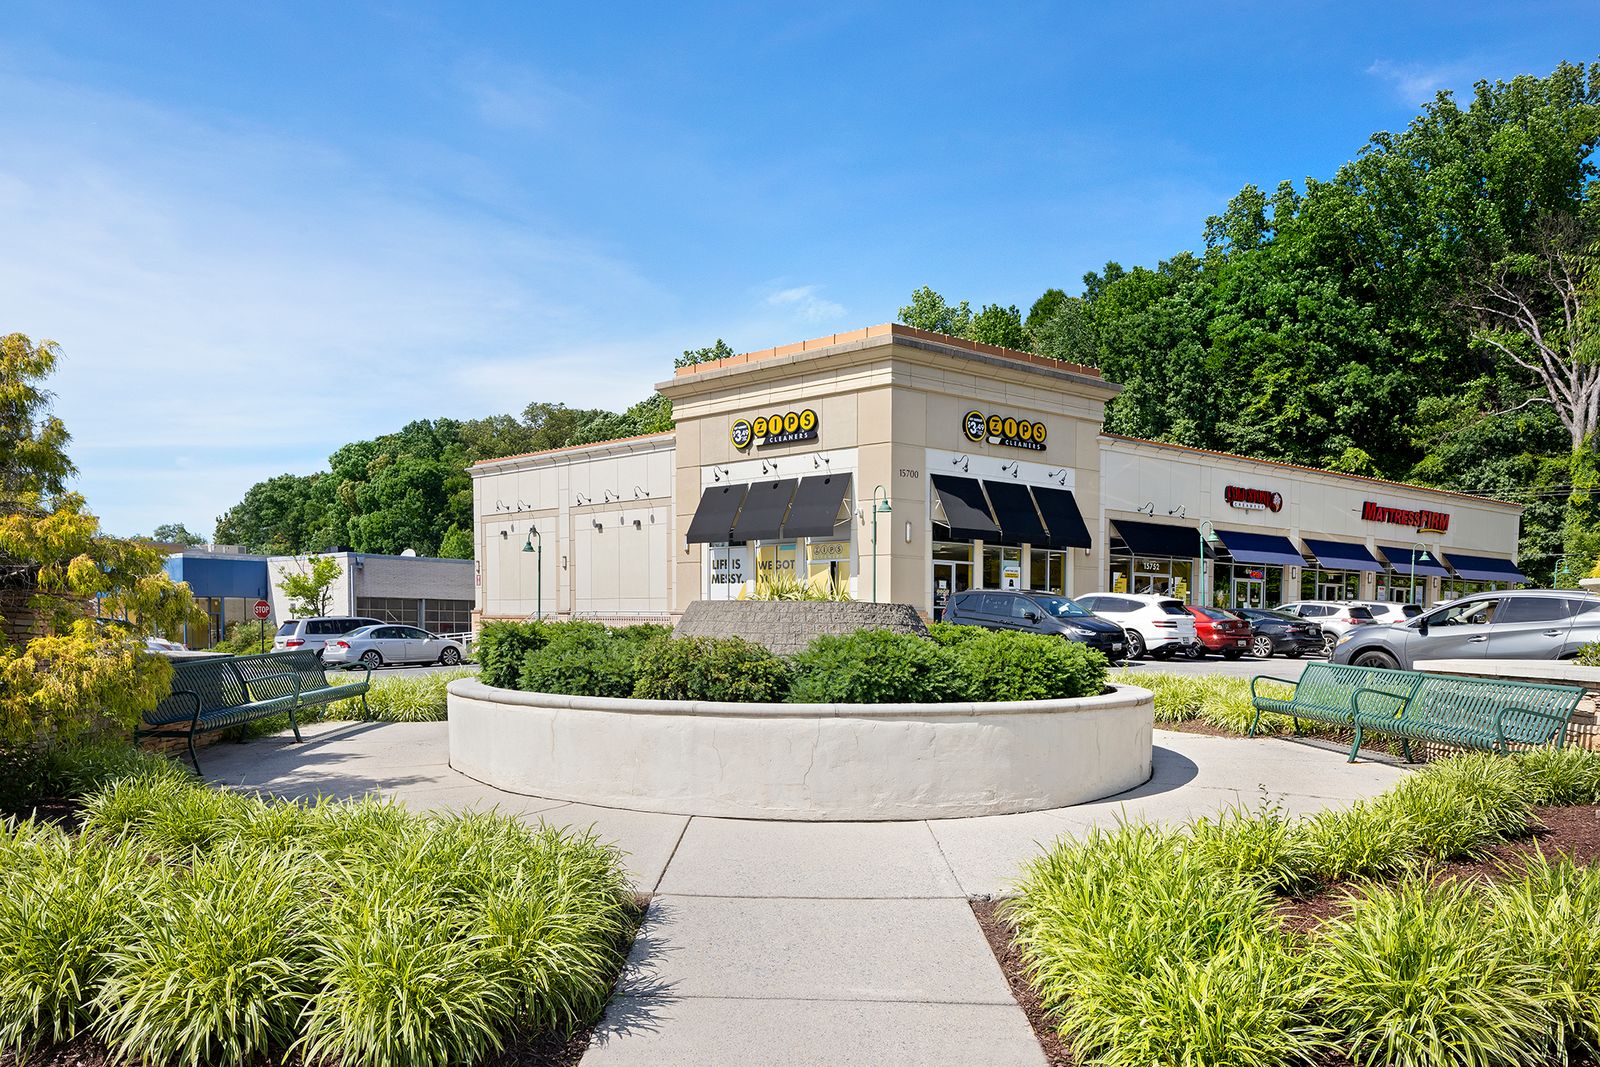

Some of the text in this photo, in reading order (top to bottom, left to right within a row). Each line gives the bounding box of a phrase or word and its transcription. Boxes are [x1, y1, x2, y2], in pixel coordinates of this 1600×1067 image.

[756, 413, 811, 434] ZIPS
[991, 418, 1043, 439] ZIPS
[769, 432, 808, 443] CLEANERS
[1005, 439, 1040, 450] CLEANERS
[899, 469, 919, 478] 15700
[732, 559, 741, 570] IS
[758, 559, 795, 570] WE GOT
[1143, 562, 1160, 571] 15752
[711, 573, 744, 584] MESSY.
[255, 606, 270, 614] STOP
